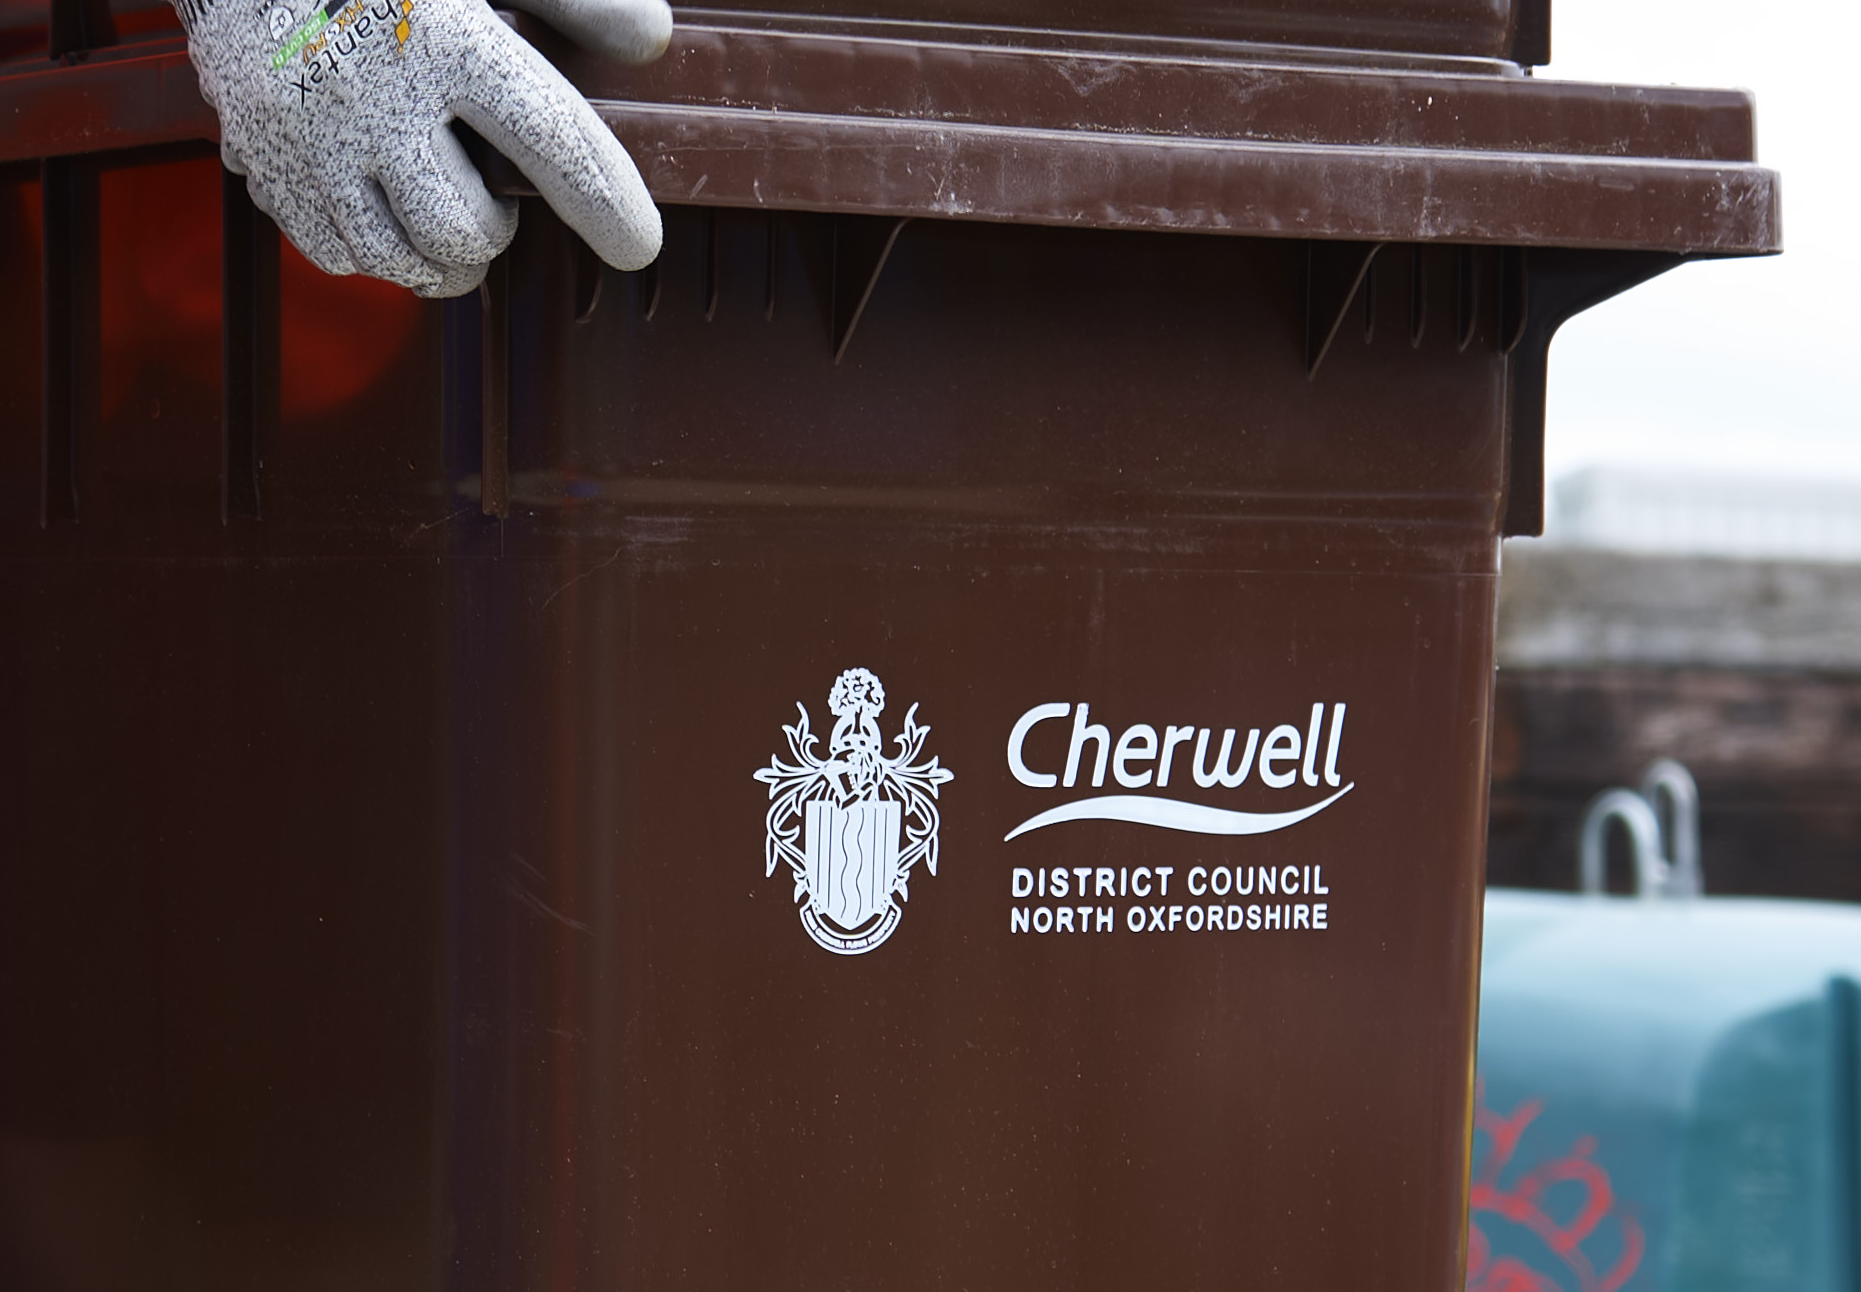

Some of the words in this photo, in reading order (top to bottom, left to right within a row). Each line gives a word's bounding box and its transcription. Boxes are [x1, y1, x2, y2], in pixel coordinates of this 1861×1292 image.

[1007, 702, 1346, 790] Cherwell
[1011, 867, 1174, 898] DISTRICT
[1187, 864, 1329, 896] COUNCIL
[1010, 906, 1114, 934] NORTH
[1126, 903, 1328, 933] OXFORDSHIRE
